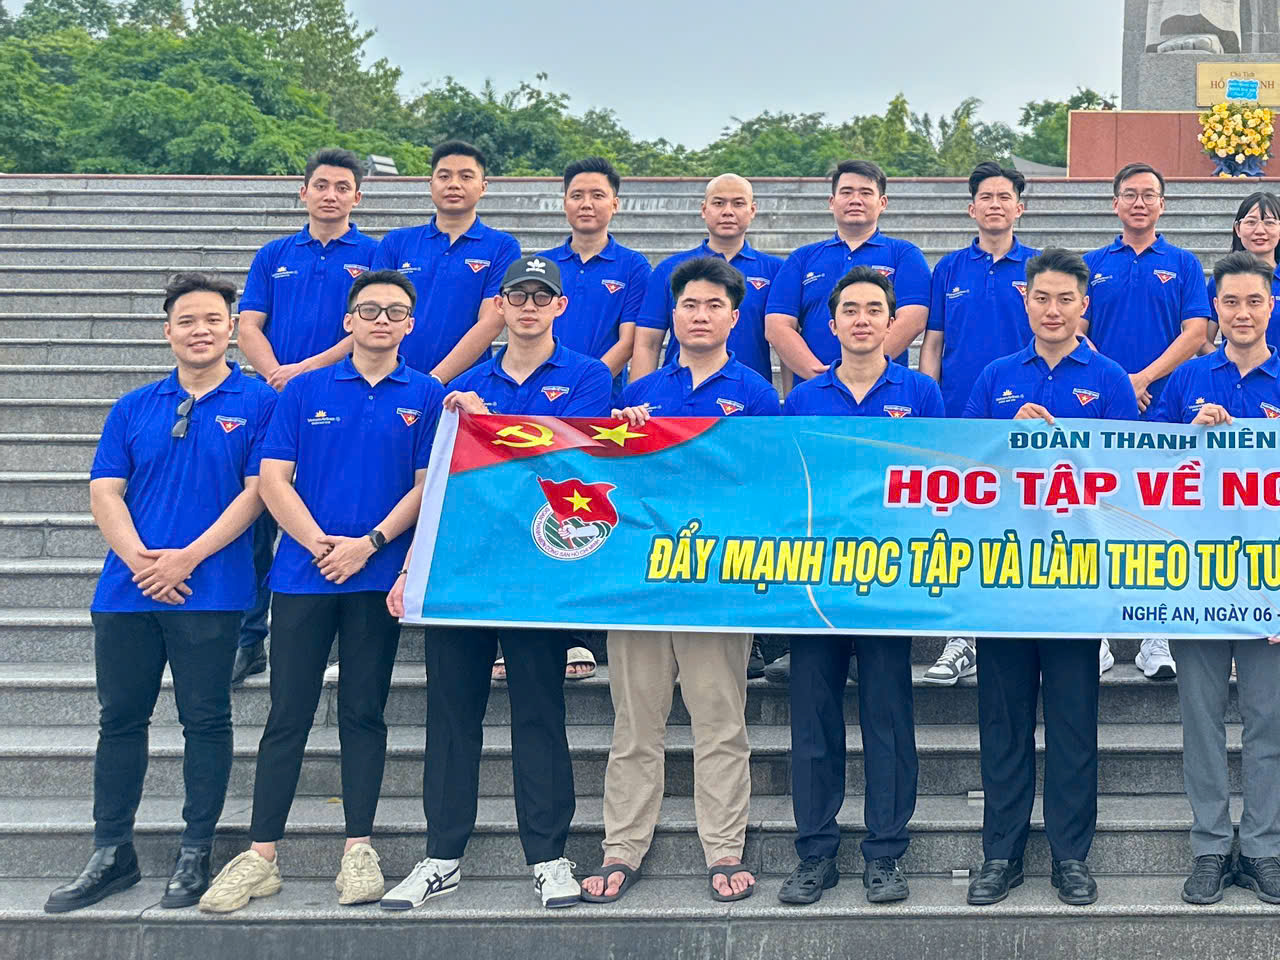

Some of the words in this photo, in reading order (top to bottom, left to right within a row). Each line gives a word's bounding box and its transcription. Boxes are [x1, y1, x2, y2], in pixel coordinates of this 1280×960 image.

[1010, 427, 1090, 450] ĐOÀN
[1100, 430, 1197, 450] THANH
[1207, 427, 1277, 450] NIÊN
[886, 467, 1001, 514] HỌC
[1015, 460, 1119, 515] TẬP
[1136, 457, 1203, 507] VỀ
[646, 520, 714, 583] ĐẨY
[722, 537, 821, 593] MẠNH
[832, 538, 899, 594] HỌC
[909, 529, 972, 596] TẬP
[980, 530, 1023, 588] VÀ
[1031, 533, 1097, 587] LÀM
[1106, 541, 1189, 588] THEO
[1198, 539, 1241, 588] TƯ
[1121, 603, 1167, 625] NGHỆ
[1171, 607, 1200, 625] AN,
[1203, 604, 1249, 622] NGÀY
[1252, 607, 1273, 622] 06
